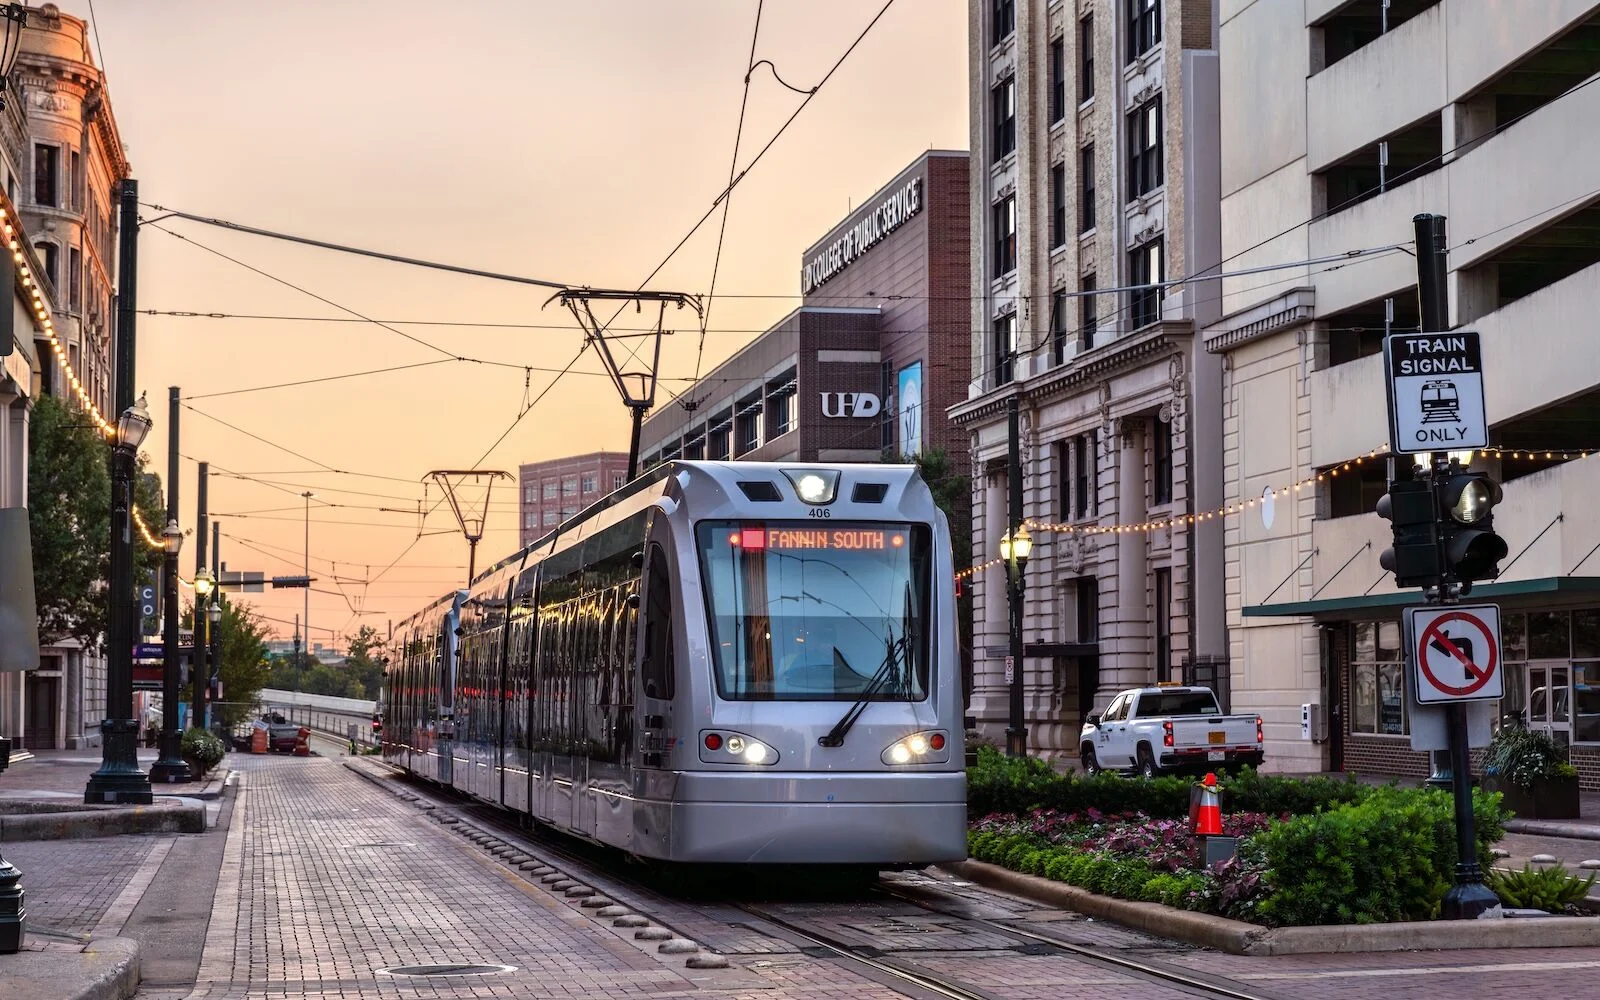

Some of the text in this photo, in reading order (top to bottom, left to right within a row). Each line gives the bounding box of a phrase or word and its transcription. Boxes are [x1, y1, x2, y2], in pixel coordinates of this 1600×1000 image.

[813, 239, 842, 286] COLLEGE
[843, 230, 854, 260] OF
[854, 207, 880, 255] PUBLIC
[882, 178, 918, 233] SERVICE
[1405, 337, 1465, 354] TRAIN
[1400, 356, 1474, 374] SIGNAL
[819, 392, 881, 418] UHD
[1415, 427, 1468, 442] ONLY
[808, 508, 831, 518] 406
[769, 531, 884, 549] FANNIN SOUTH
